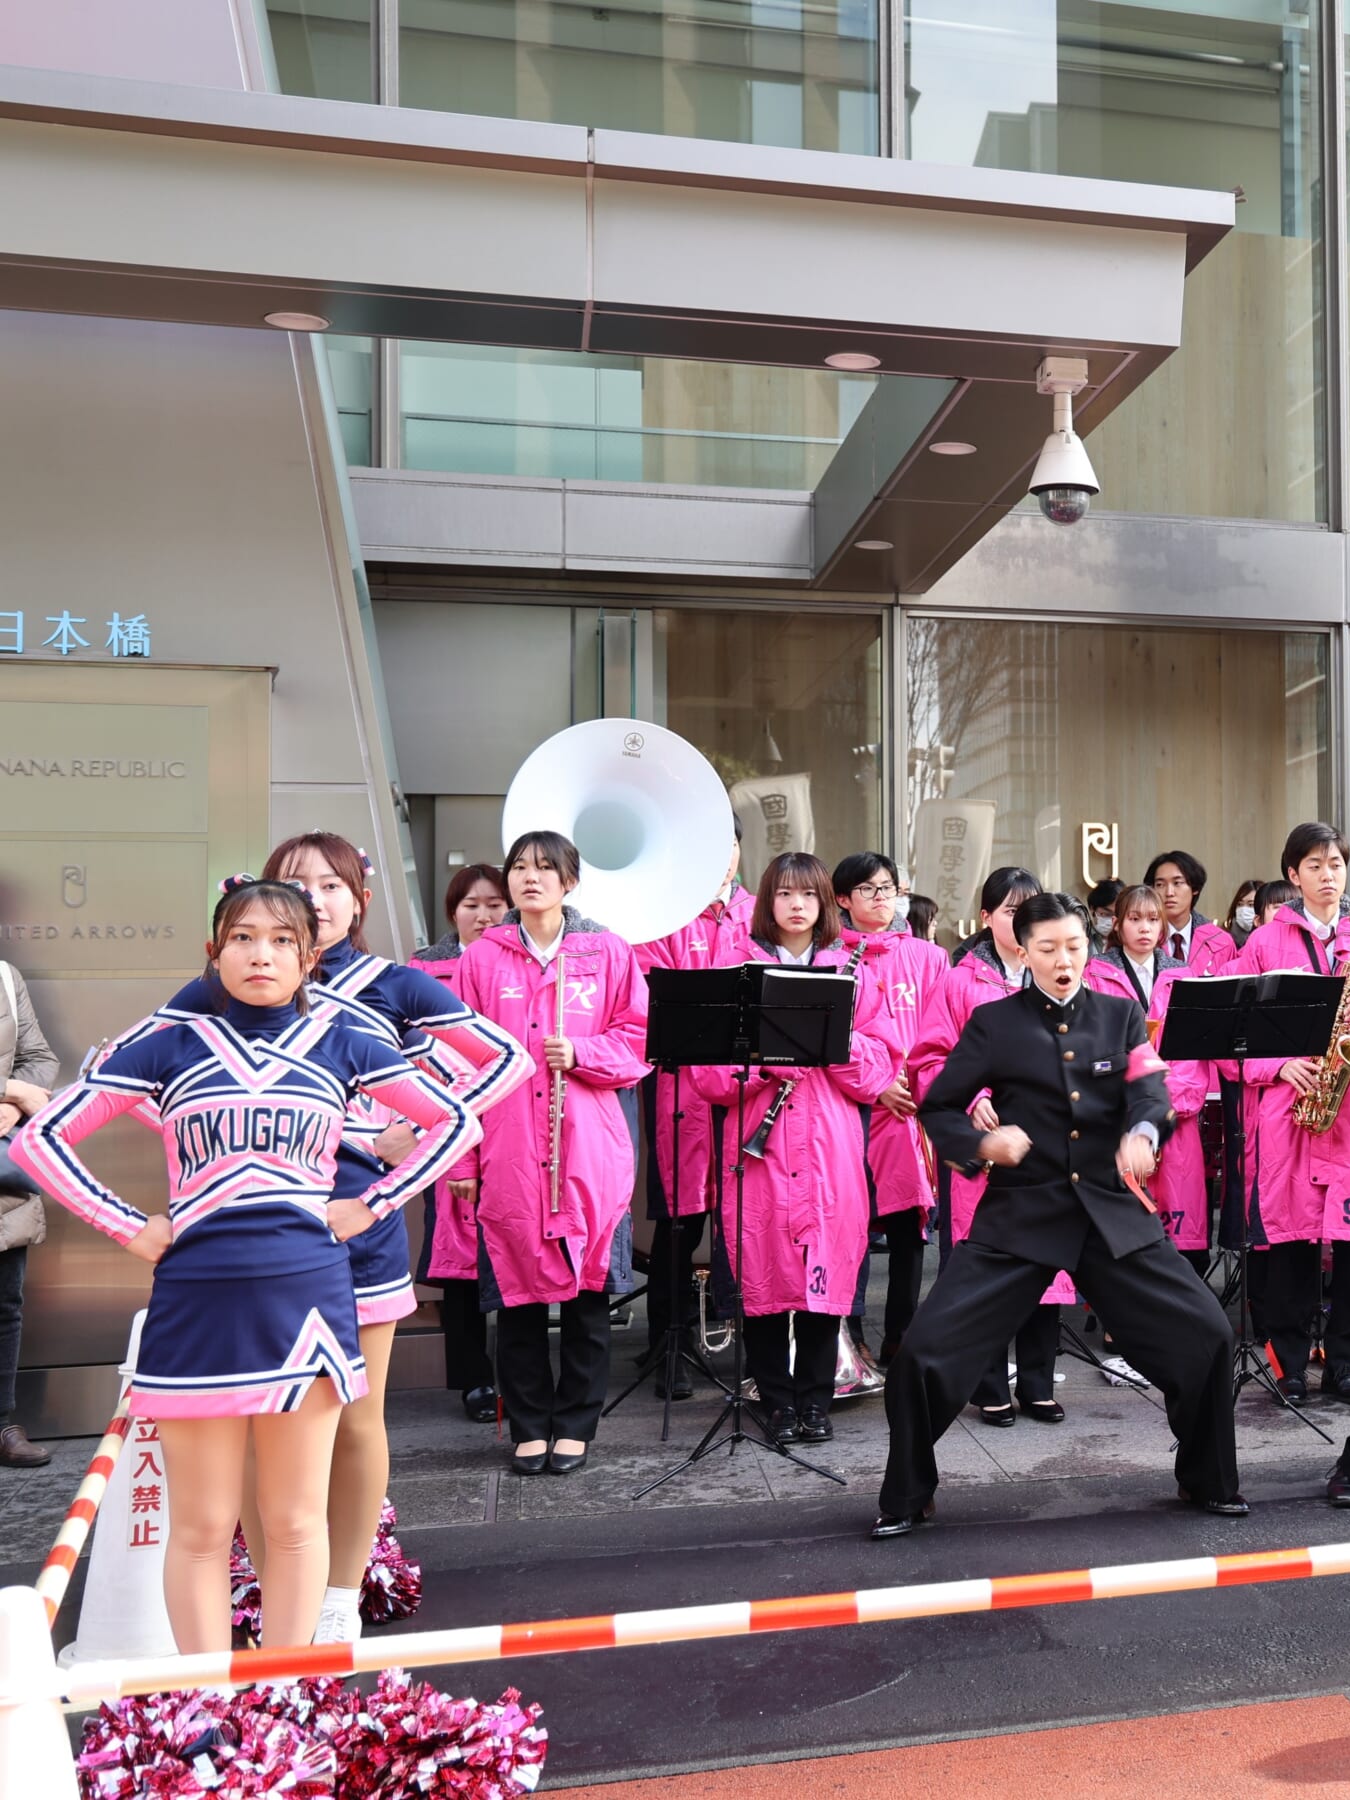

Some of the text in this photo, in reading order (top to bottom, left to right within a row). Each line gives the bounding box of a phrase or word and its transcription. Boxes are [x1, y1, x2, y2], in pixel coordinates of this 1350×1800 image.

[71, 759, 187, 778] REPUBLIC
[0, 924, 176, 940] ITED ARROWS
[174, 1105, 333, 1192] KOKUGAKU
[130, 1417, 162, 1547] 立入禁止
